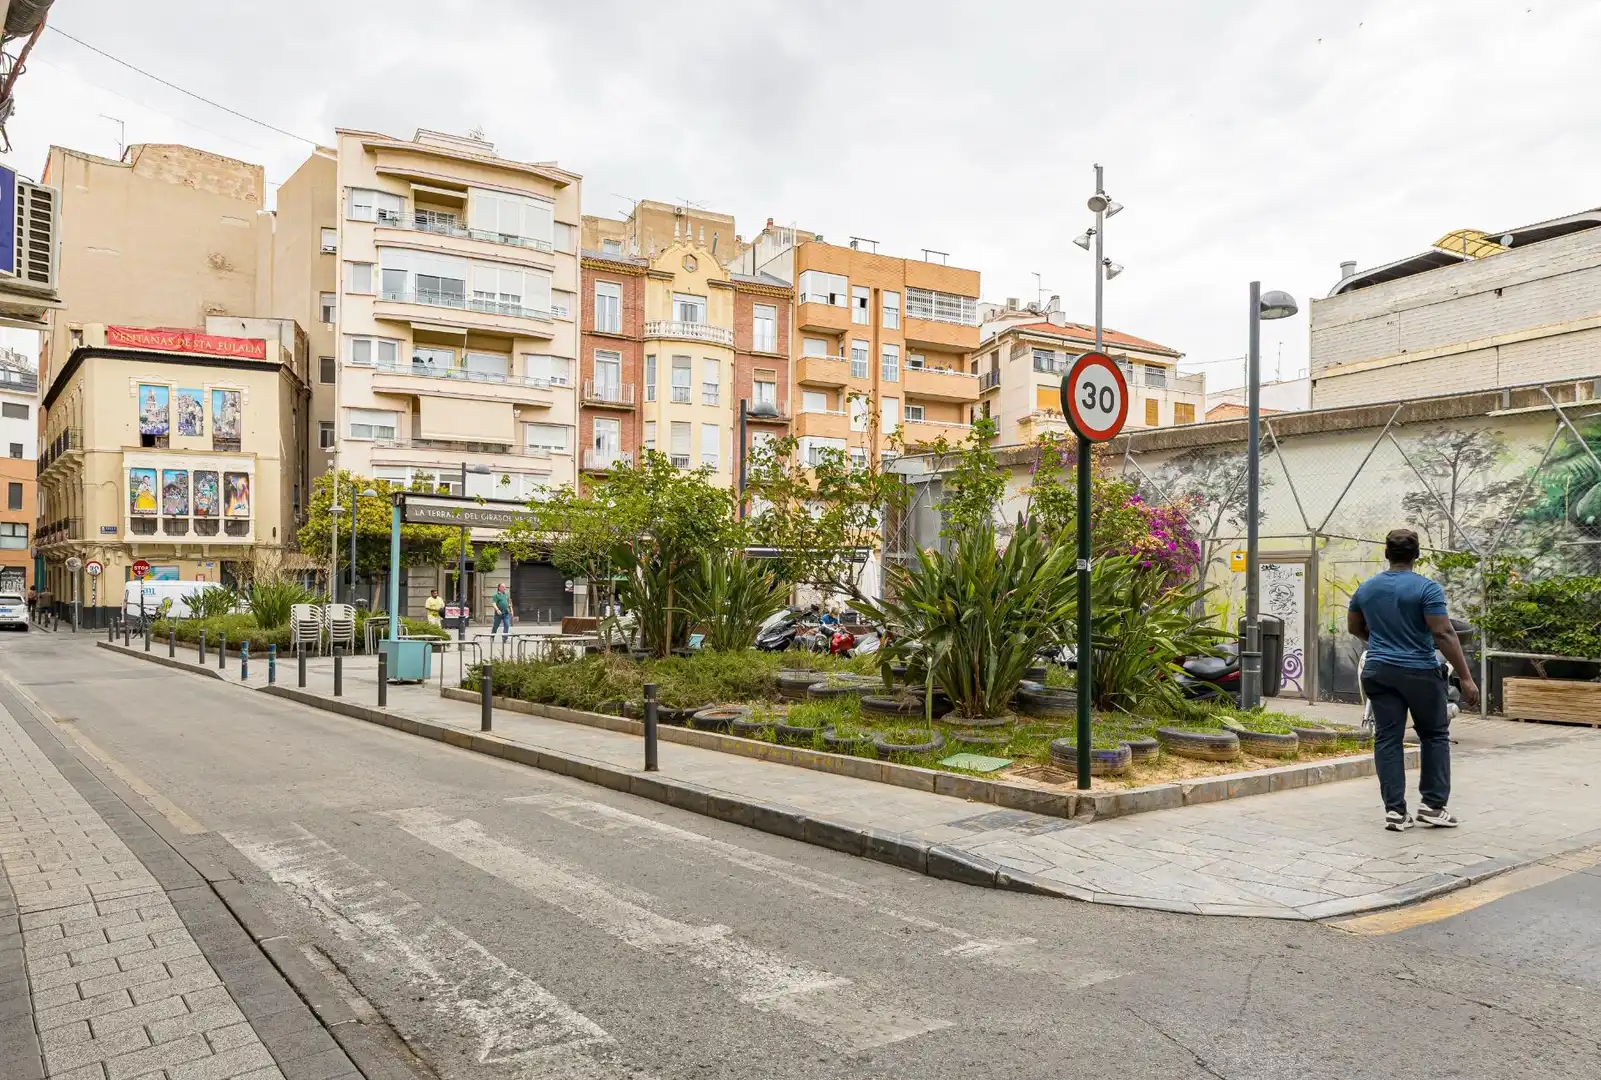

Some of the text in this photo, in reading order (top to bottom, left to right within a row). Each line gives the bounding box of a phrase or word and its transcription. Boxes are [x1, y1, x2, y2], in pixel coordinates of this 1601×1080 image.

[111, 332, 262, 354] VENTANAS DE STA EULALIA
[1081, 381, 1115, 414] 30
[414, 509, 425, 517] LA
[427, 510, 461, 519] TERRAA
[464, 512, 478, 520] DEL
[481, 513, 513, 523] GIRASOL
